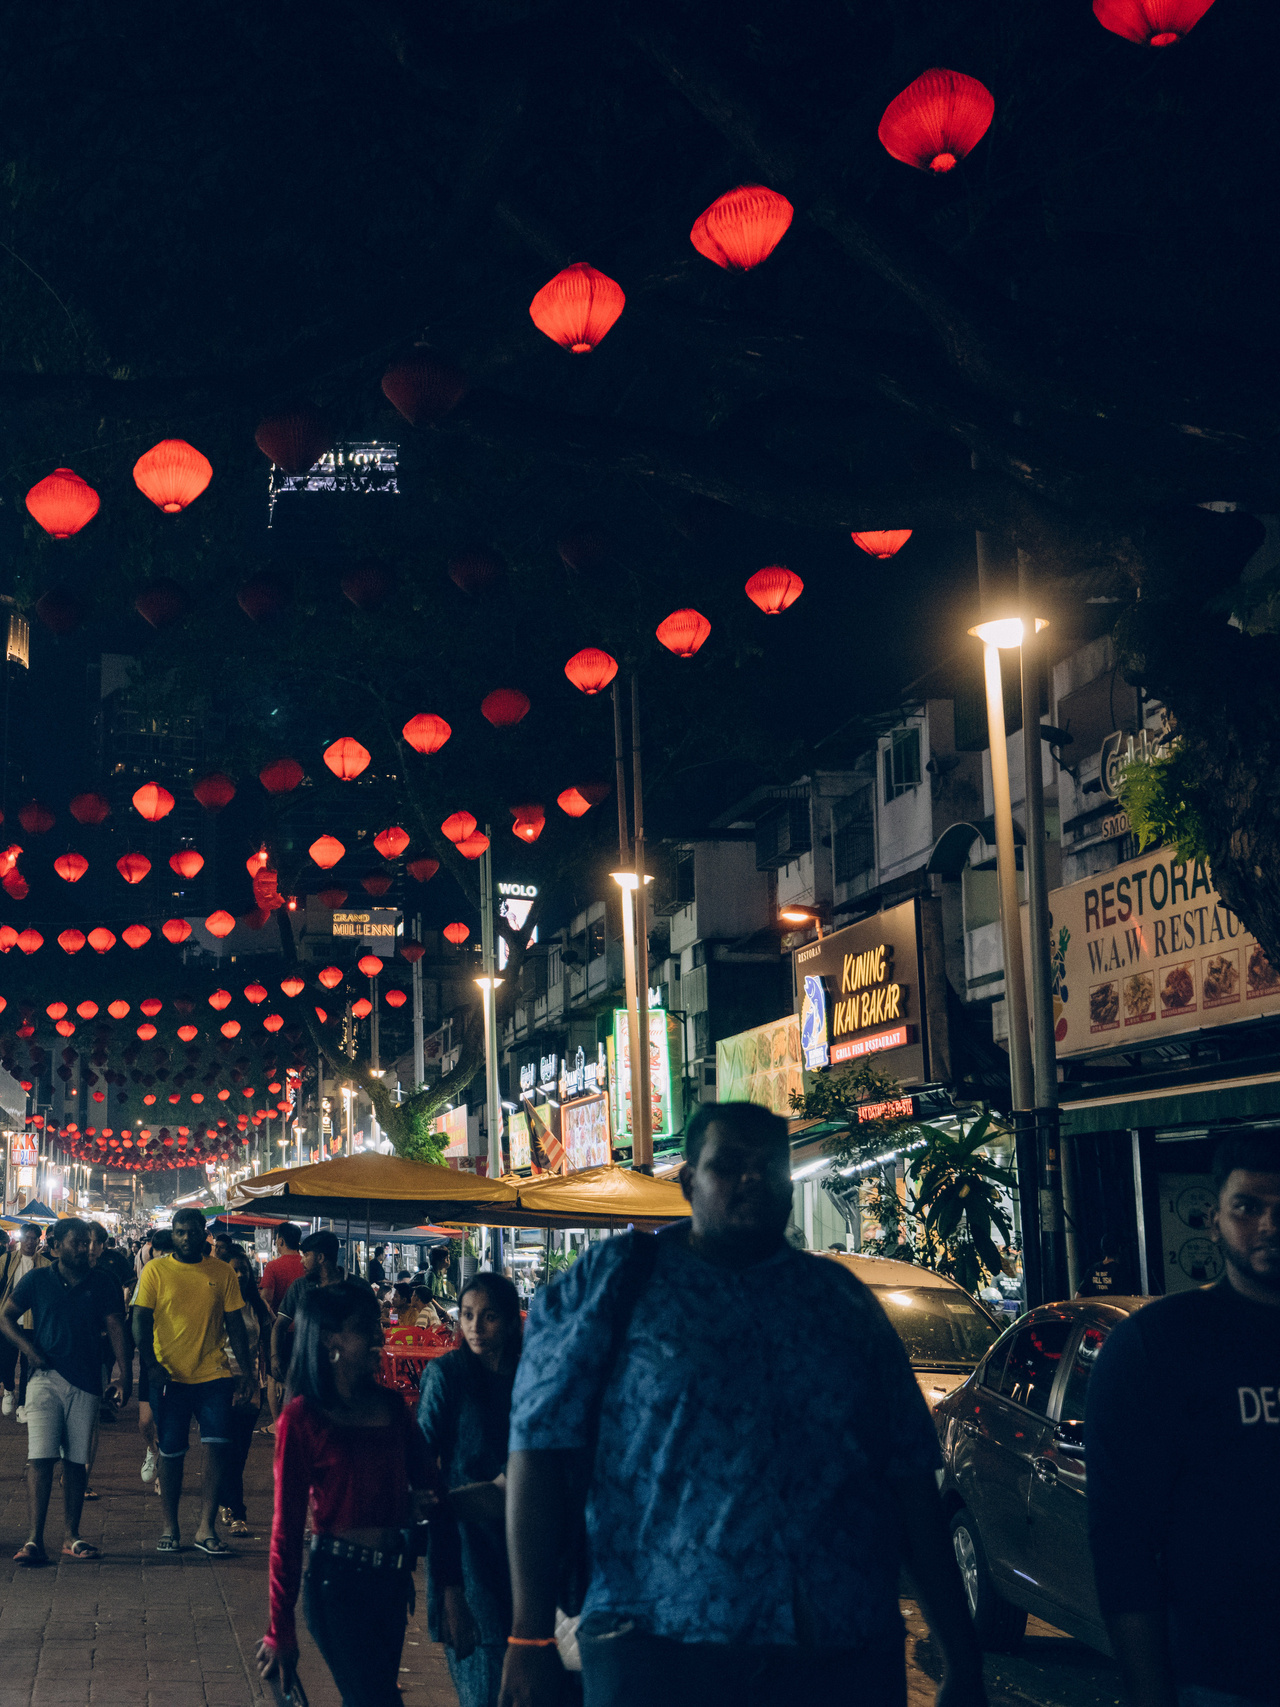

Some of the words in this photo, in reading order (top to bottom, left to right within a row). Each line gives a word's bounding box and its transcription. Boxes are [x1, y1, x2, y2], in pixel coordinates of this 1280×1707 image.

[497, 882, 538, 897] WOLO
[1084, 857, 1213, 933] RESTORA
[333, 913, 370, 923] GRAND
[1153, 902, 1250, 958] RESTAU
[797, 944, 821, 963] RESTORAN
[841, 944, 886, 994] KUNING
[833, 994, 860, 1036] IKAN
[861, 983, 900, 1028] BAKAR
[852, 1042, 865, 1056] FISH
[865, 1032, 901, 1052] RESTAURANT
[13, 1133, 36, 1150] KK
